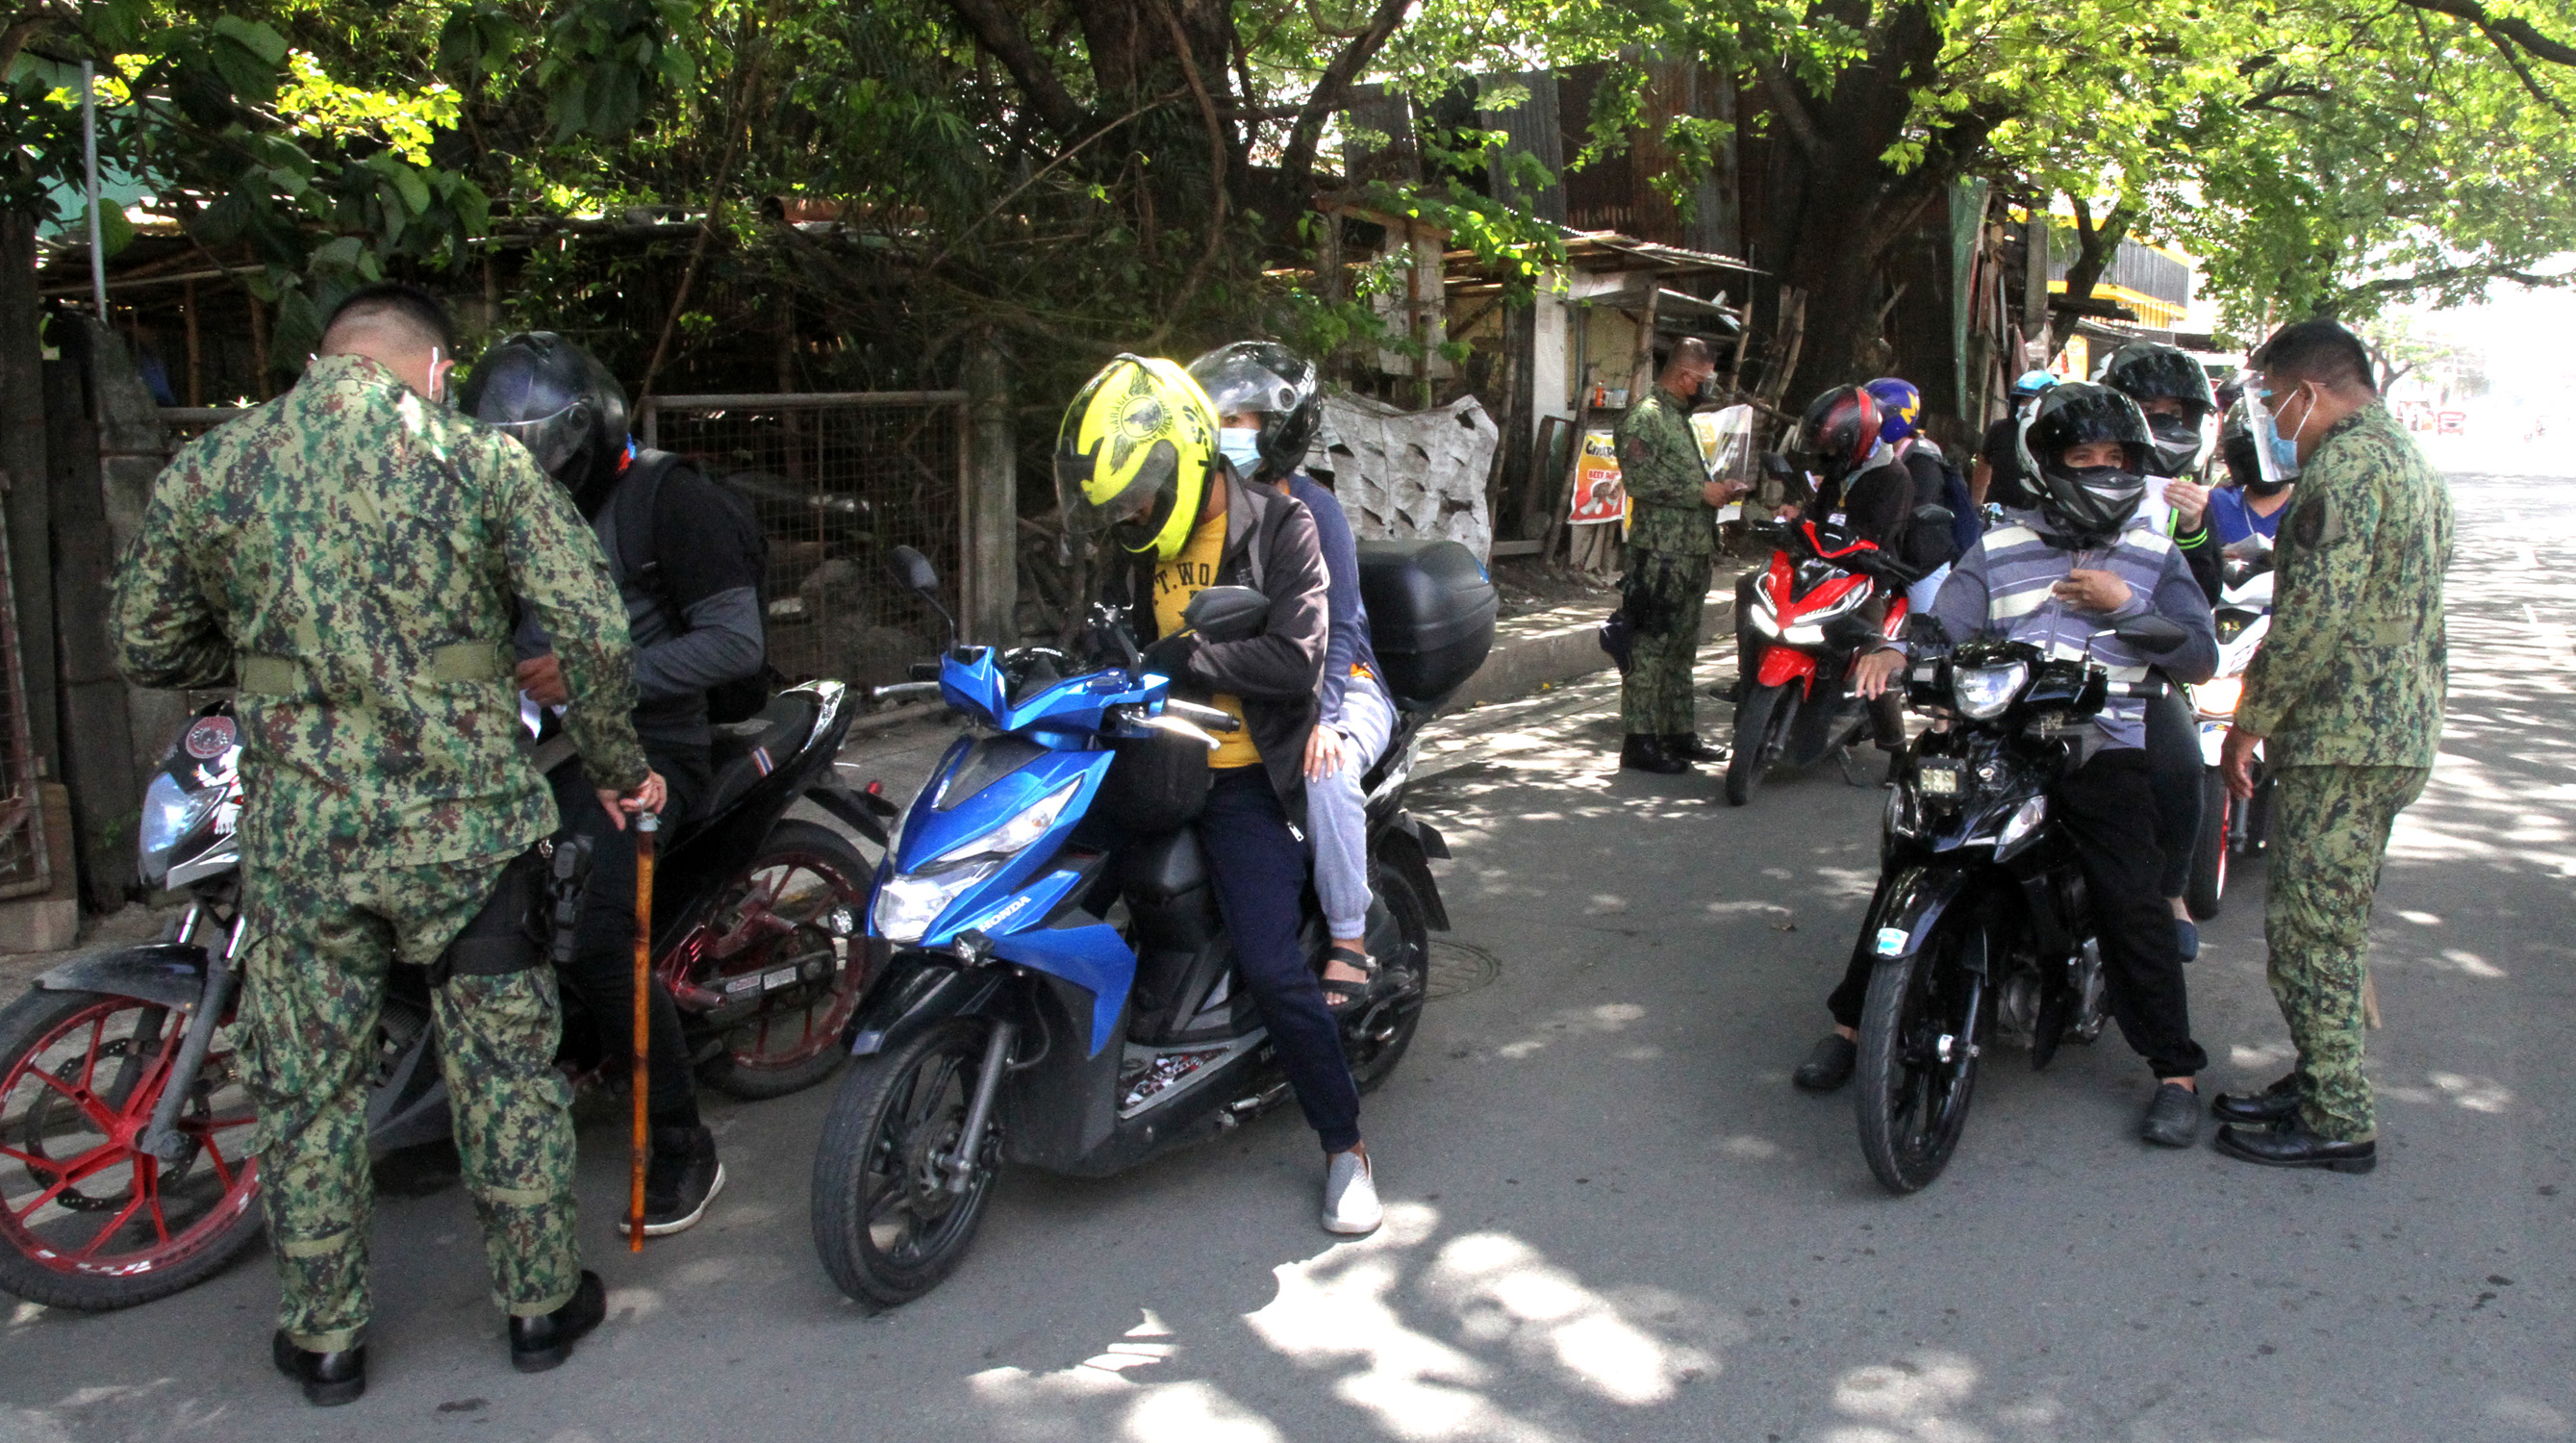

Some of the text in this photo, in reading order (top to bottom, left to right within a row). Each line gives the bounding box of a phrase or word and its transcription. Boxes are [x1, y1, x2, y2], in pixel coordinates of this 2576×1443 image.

[1109, 393, 1130, 434] GARAGE
[1588, 469, 1604, 480] BEEF
[977, 896, 1032, 933] HONDA
